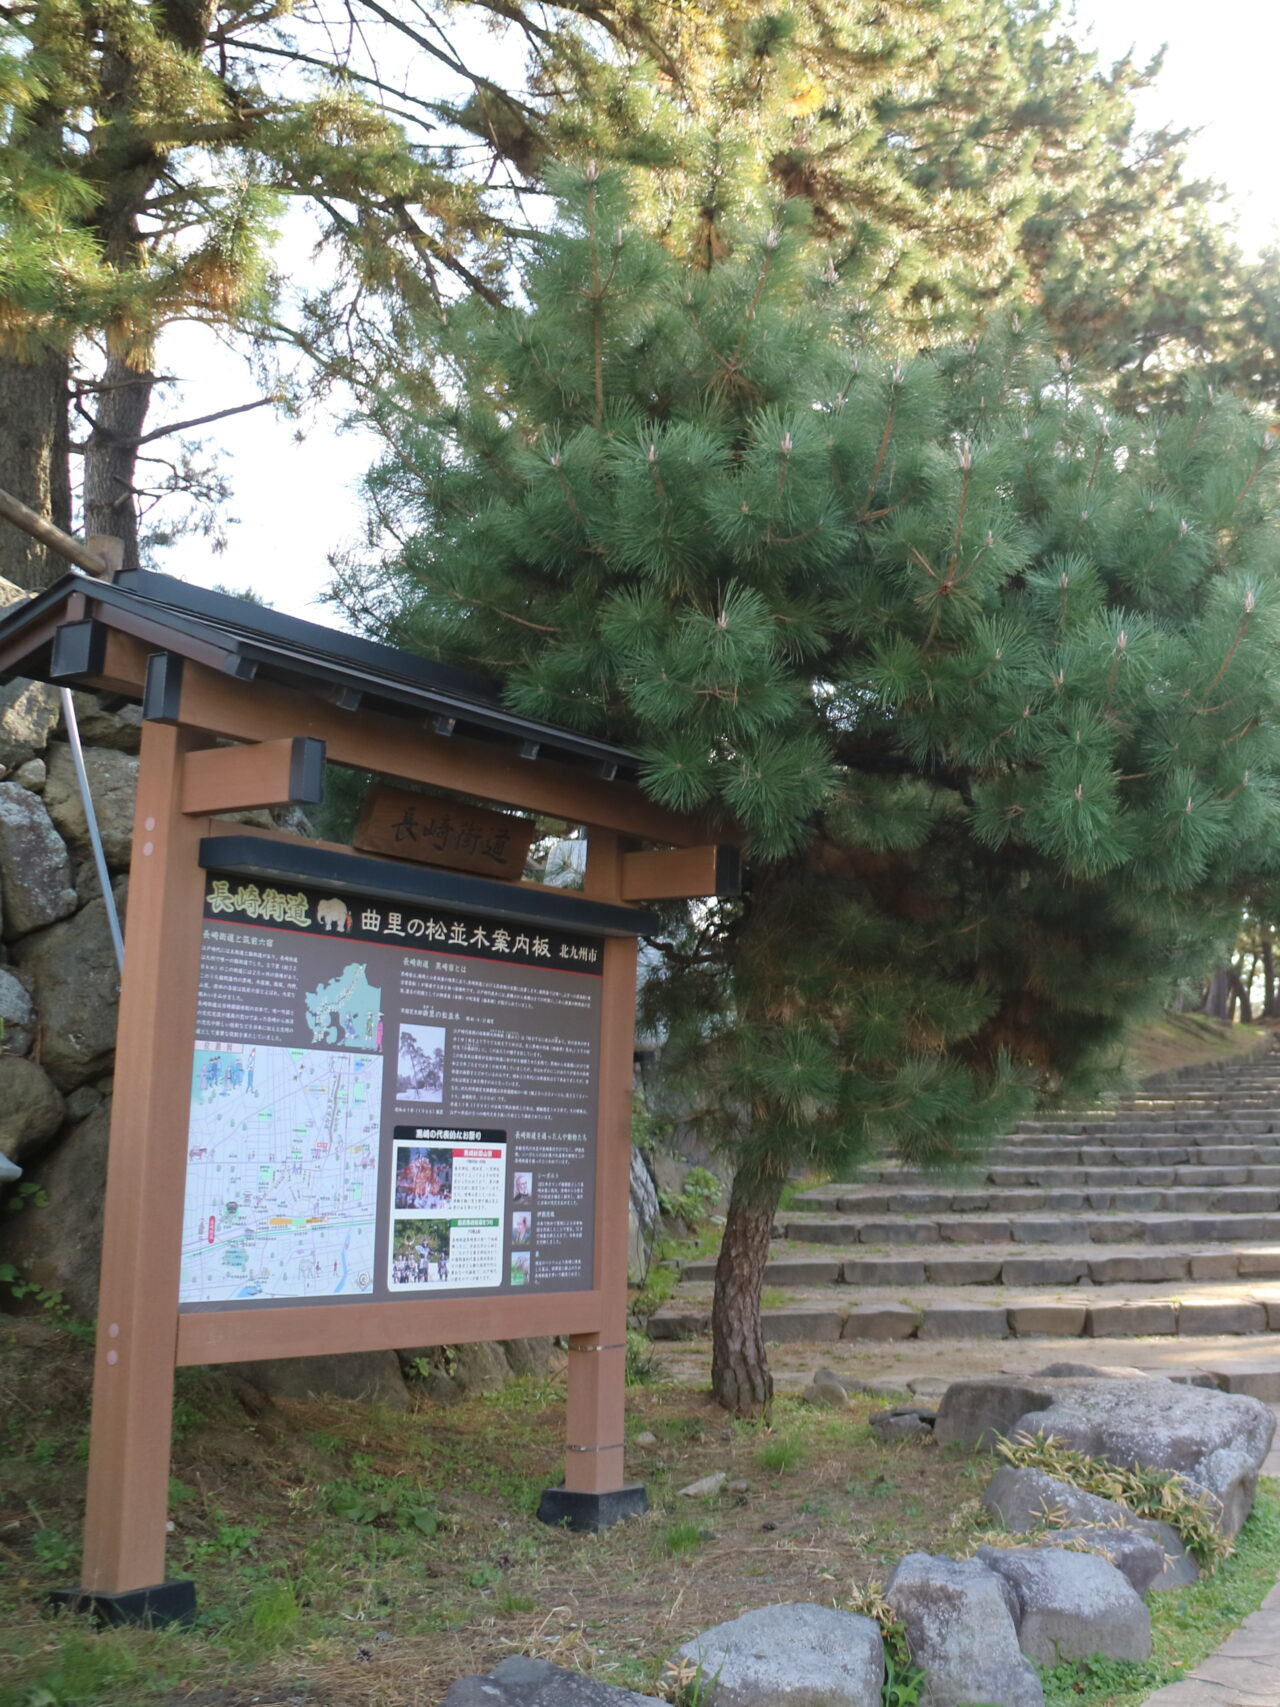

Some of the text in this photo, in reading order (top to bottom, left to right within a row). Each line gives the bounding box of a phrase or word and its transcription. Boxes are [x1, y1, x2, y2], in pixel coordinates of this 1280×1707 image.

[391, 807, 512, 864] 長崎街道
[206, 880, 312, 927] 長崎街道
[361, 908, 598, 964] 曲里の松並木案内板 北九州市
[415, 1129, 482, 1141] 黒崎の代表的なお祭り
